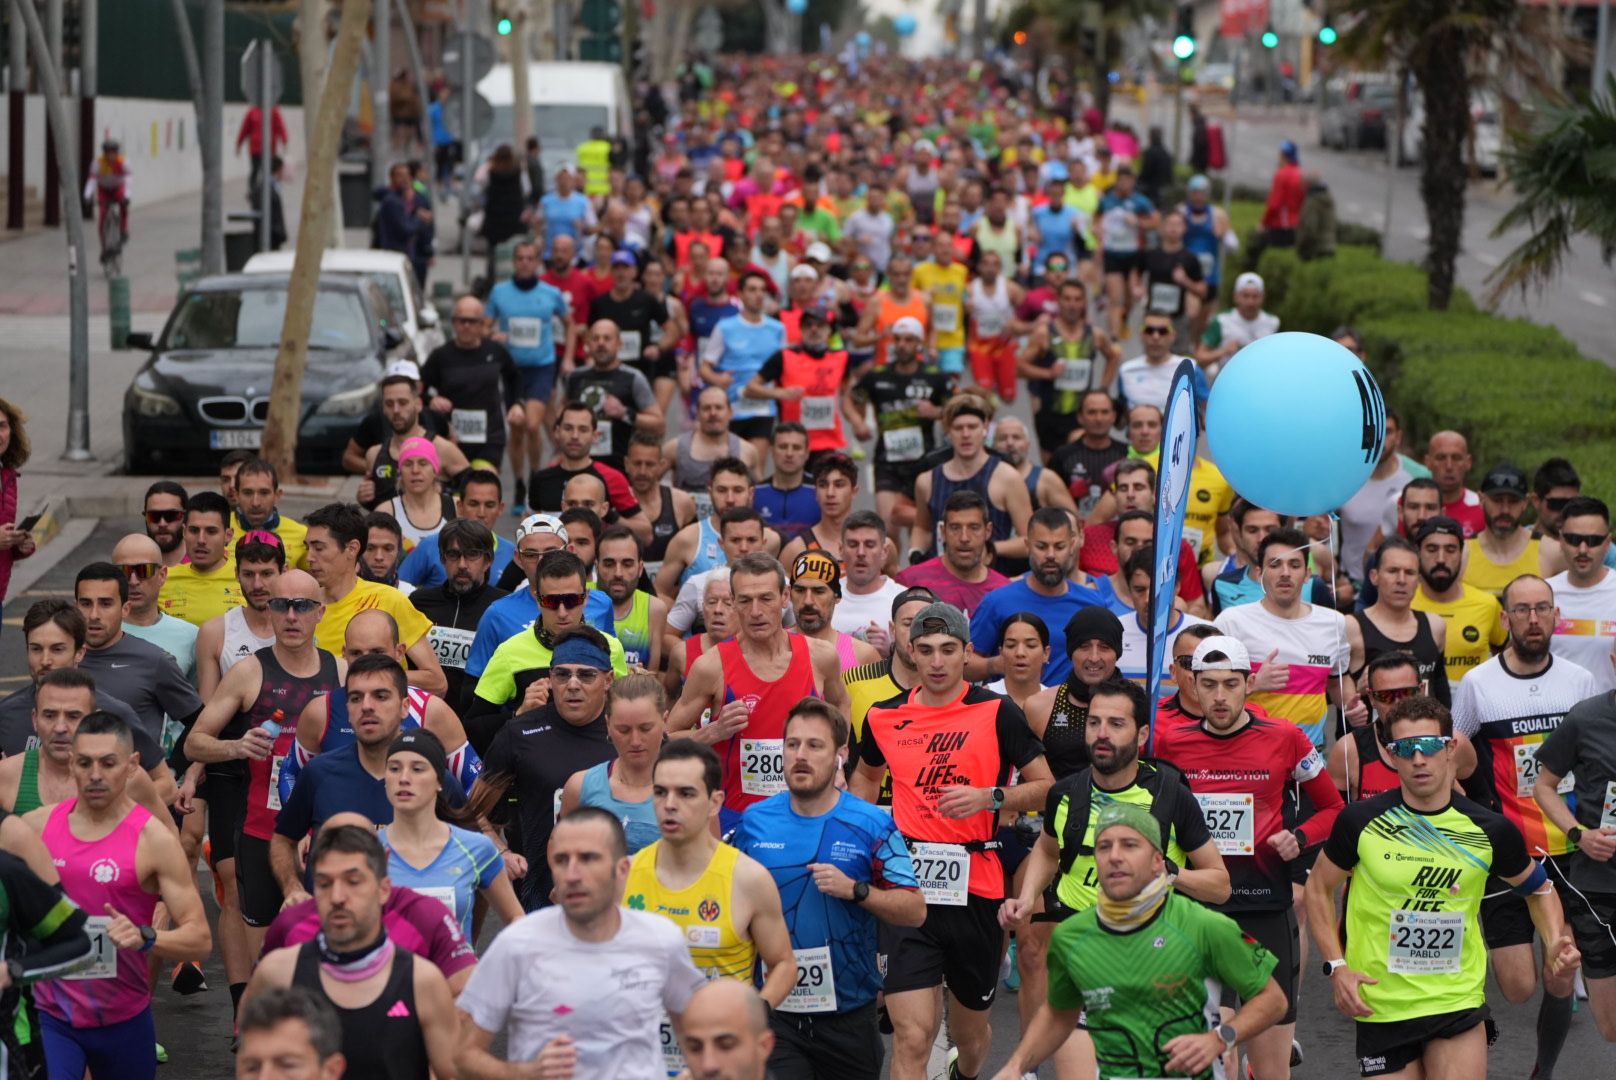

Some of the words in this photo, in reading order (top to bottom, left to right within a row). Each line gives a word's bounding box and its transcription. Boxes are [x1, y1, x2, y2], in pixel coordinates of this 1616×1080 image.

[430, 638, 471, 661] 2570
[1418, 661, 1436, 674] gel
[1512, 716, 1564, 734] EQUALITY
[925, 731, 970, 753] RUN
[746, 754, 783, 774] 280
[929, 753, 951, 765] FOR
[1522, 758, 1543, 778] 26
[761, 774, 783, 782] JOAN
[914, 765, 957, 788] LIFE
[1207, 769, 1270, 781] ADDICTION
[1206, 810, 1245, 831] 527
[1210, 831, 1236, 839] NACIO
[911, 859, 961, 881] 2720
[1411, 866, 1463, 888] RUN
[920, 880, 948, 889] ROBER
[1231, 886, 1271, 895] luria.com
[1415, 888, 1440, 899] FOR
[1396, 926, 1456, 950] 2322
[1410, 949, 1441, 959] PABLO
[796, 965, 824, 987] 29
[790, 988, 815, 996] QUEL
